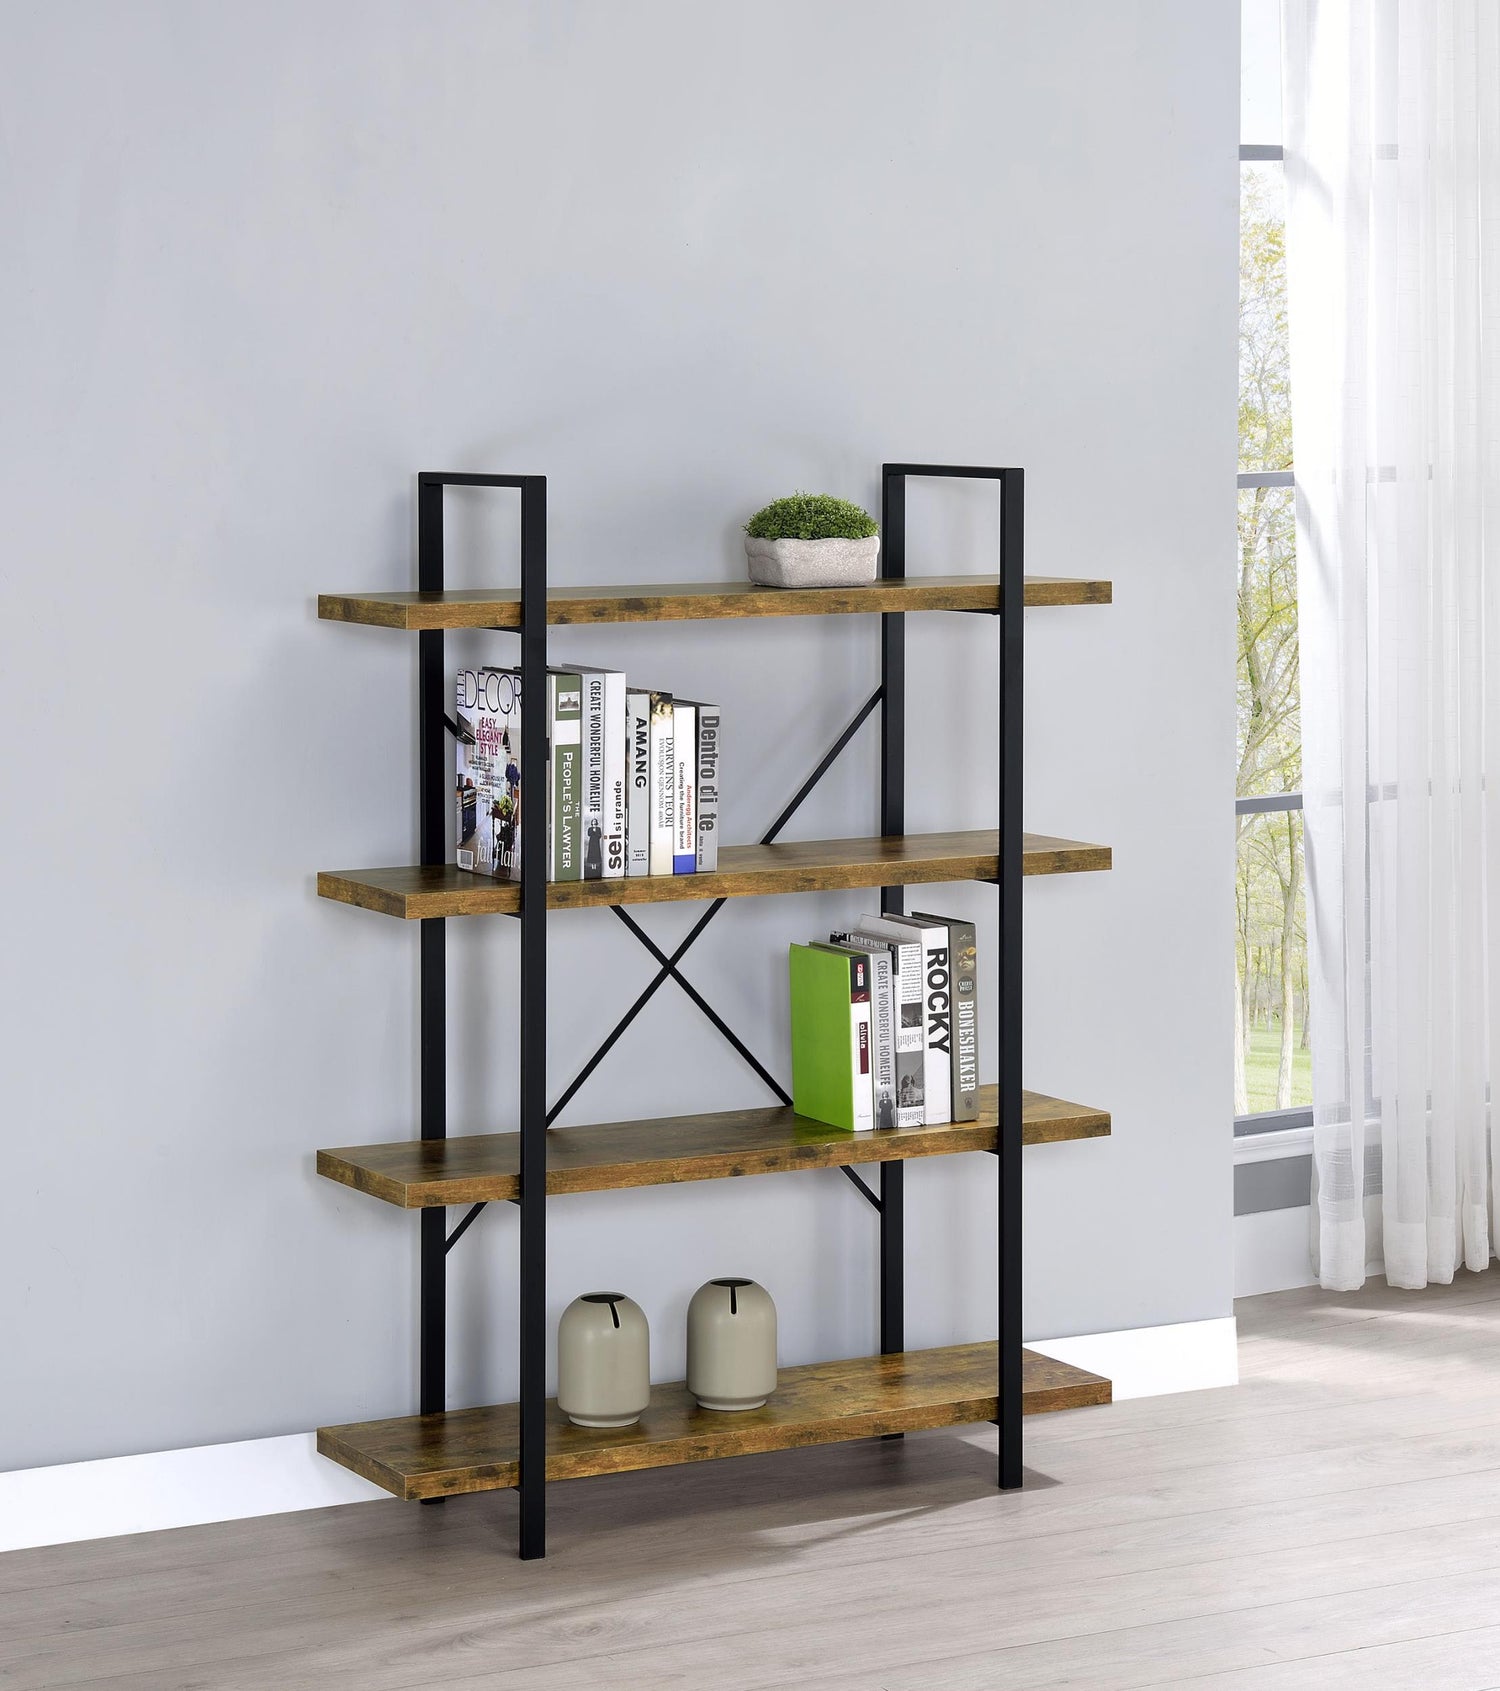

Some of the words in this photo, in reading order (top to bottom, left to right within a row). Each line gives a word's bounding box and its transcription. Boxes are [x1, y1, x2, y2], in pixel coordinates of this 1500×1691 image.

[464, 670, 521, 715] DECOR
[590, 680, 601, 711] CREATE
[476, 729, 502, 744] ELEGANT
[480, 743, 498, 756] STYLE
[589, 714, 601, 767] WONDERFUL
[635, 717, 647, 788] AMANG
[700, 715, 720, 779] Dentro
[562, 752, 573, 812] PEOPLE'S
[665, 737, 674, 790] DARWINS
[589, 770, 601, 812] HOMELIFE
[613, 780, 623, 819] grande
[665, 792, 674, 828] TEORI
[699, 785, 718, 803] di
[562, 815, 573, 869] LAWYER
[613, 822, 622, 831] si
[699, 812, 717, 831] te
[877, 960, 888, 989] CREATE
[878, 992, 890, 1043] WONDERFUL
[927, 947, 949, 1054] ROCKY
[879, 1045, 891, 1085] HOMELIFE
[958, 1000, 976, 1092] BONESHAKER
